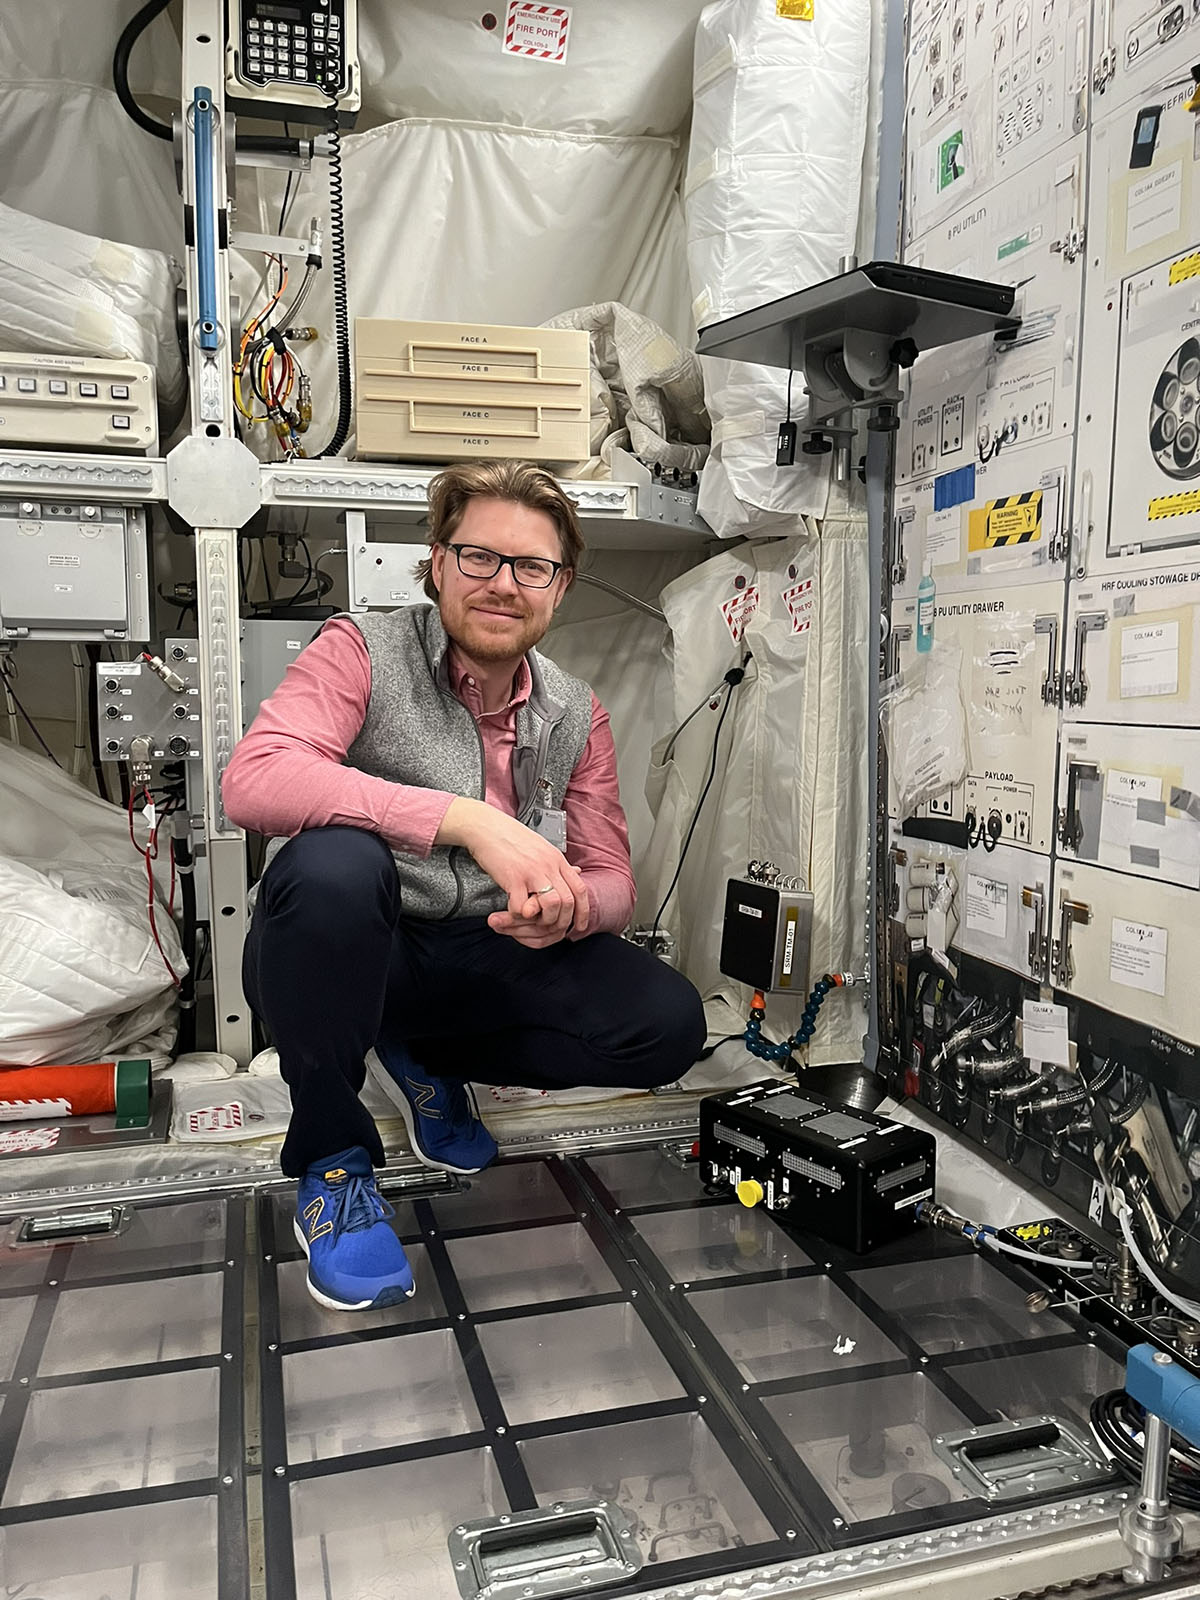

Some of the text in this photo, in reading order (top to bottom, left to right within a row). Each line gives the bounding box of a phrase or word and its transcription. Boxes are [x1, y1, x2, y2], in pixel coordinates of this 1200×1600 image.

[516, 11, 550, 22] EMERGENCY
[516, 23, 559, 38] FIRE PORT
[952, 222, 962, 237] PU
[962, 207, 987, 231] UTILITY
[946, 394, 961, 405] RACK
[917, 405, 933, 418] UTILITY
[944, 403, 962, 416] POWER
[917, 415, 933, 427] POWER
[996, 510, 1018, 519] WARNING
[1101, 582, 1115, 591] HRF
[1116, 577, 1148, 590] COOLING
[1149, 573, 1189, 586] STOWAGE
[938, 607, 947, 617] PU
[948, 604, 972, 616] UTILITY
[972, 601, 1005, 613] DRAWER
[984, 770, 1014, 782] PAYLOAD
[784, 928, 794, 968] SRM-TM-01
[1092, 1186, 1100, 1203] A
[1095, 1205, 1102, 1220] 4
